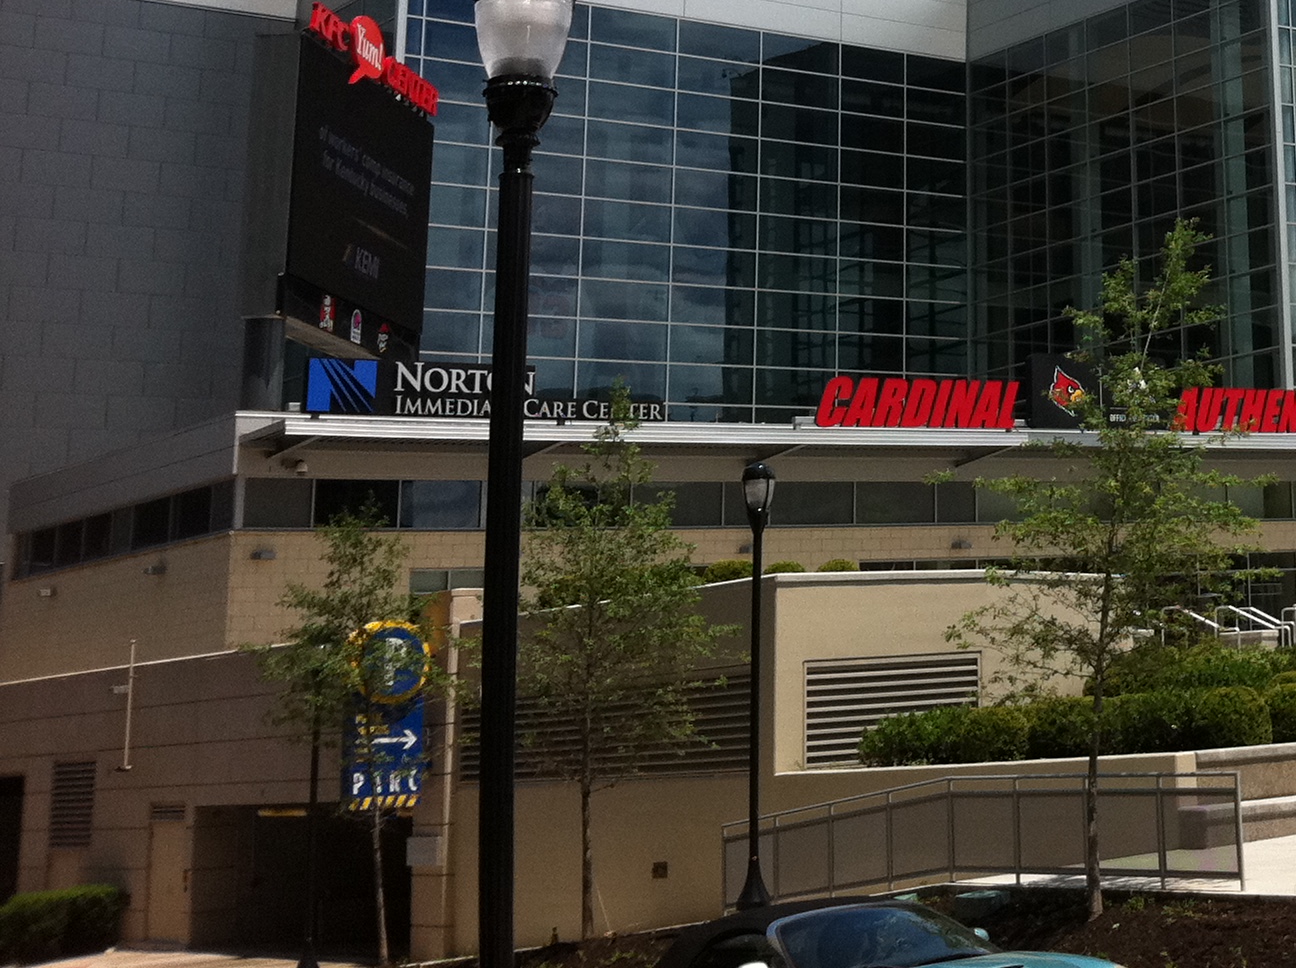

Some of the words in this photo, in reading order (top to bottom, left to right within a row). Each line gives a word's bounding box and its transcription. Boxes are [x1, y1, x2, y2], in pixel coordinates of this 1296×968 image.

[309, 1, 351, 52] KFC
[356, 23, 384, 71] Yum!
[384, 56, 440, 117] CENTER
[393, 360, 536, 396] NORTN
[523, 398, 577, 419] CARE
[582, 400, 663, 421] CETER
[815, 375, 1020, 430] CARDINAL
